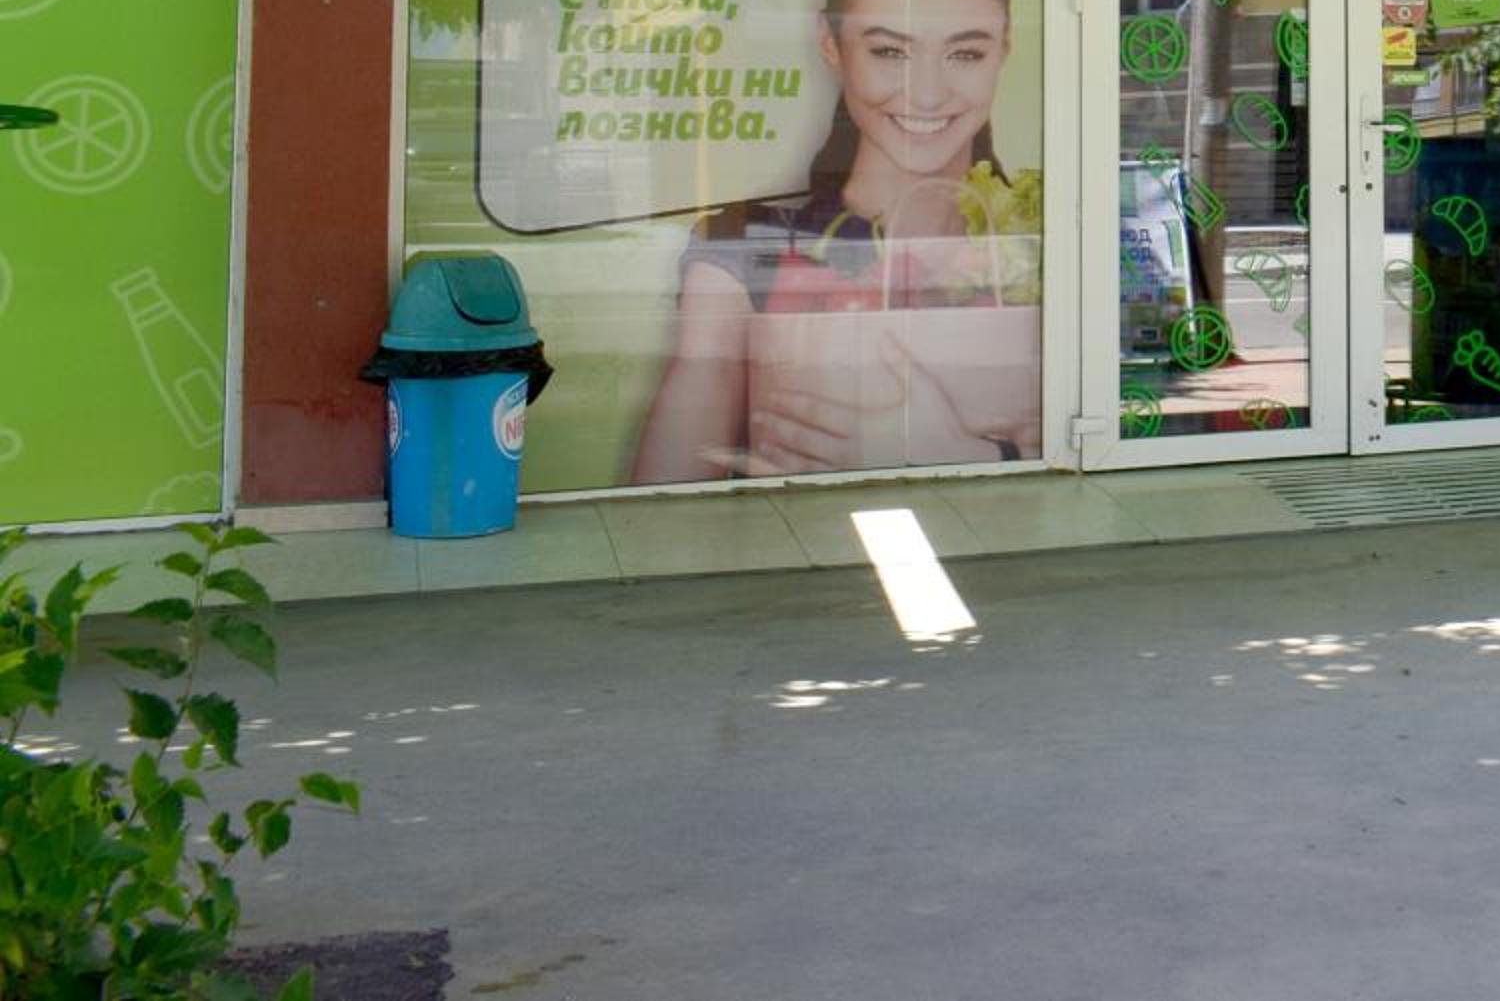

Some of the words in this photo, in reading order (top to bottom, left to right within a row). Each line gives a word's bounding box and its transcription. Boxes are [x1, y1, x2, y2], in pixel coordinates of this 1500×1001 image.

[556, 10, 723, 55] който
[557, 58, 734, 97] всички
[744, 67, 801, 97] ни
[556, 99, 777, 142] познава.
